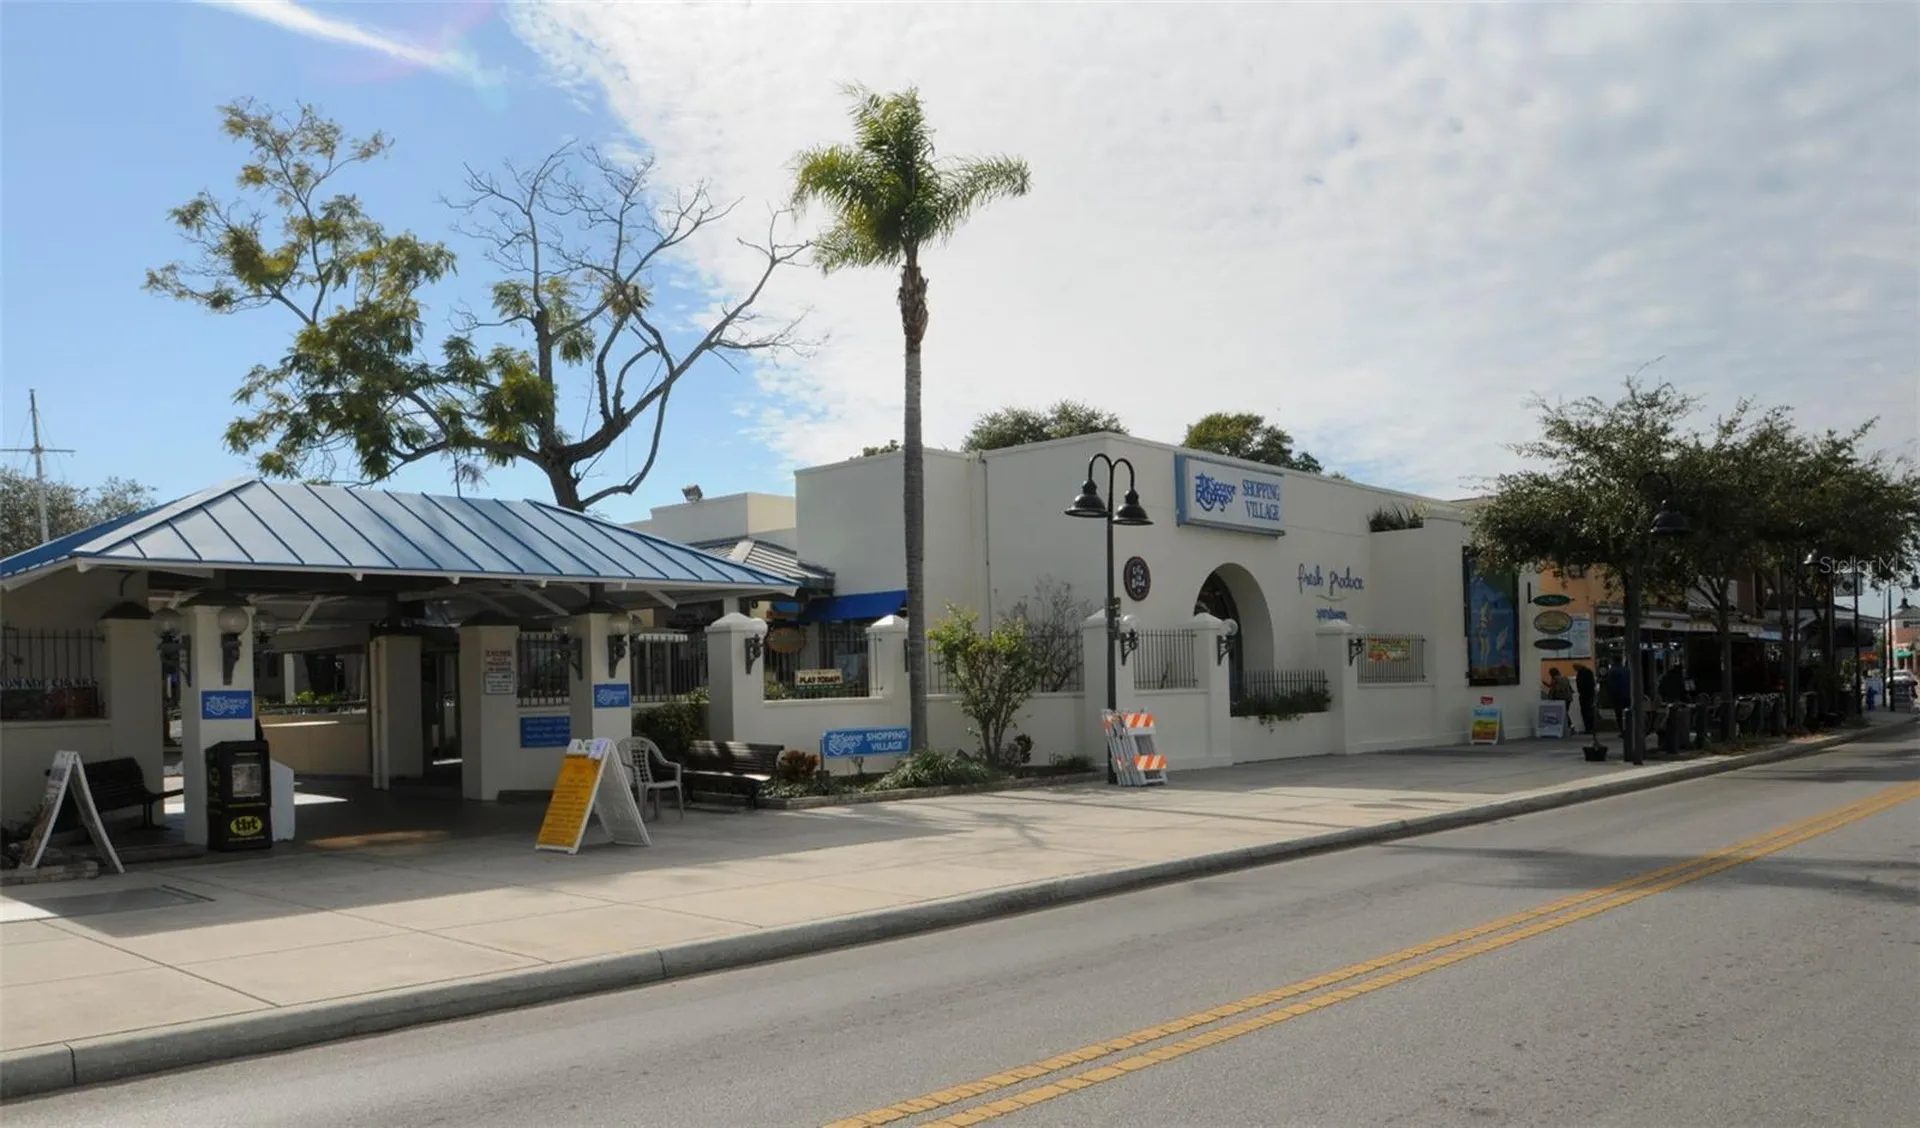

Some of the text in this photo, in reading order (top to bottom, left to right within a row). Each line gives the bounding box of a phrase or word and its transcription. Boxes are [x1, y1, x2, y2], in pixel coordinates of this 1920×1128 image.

[1242, 479, 1279, 502] SHOPPING
[1246, 501, 1279, 521] VILLAGE
[1297, 562, 1364, 596] fresh produce
[800, 676, 816, 684] PLAY
[866, 731, 907, 742] SHOPPING
[871, 741, 902, 750] VILLAGE
[235, 818, 257, 830] tbt
